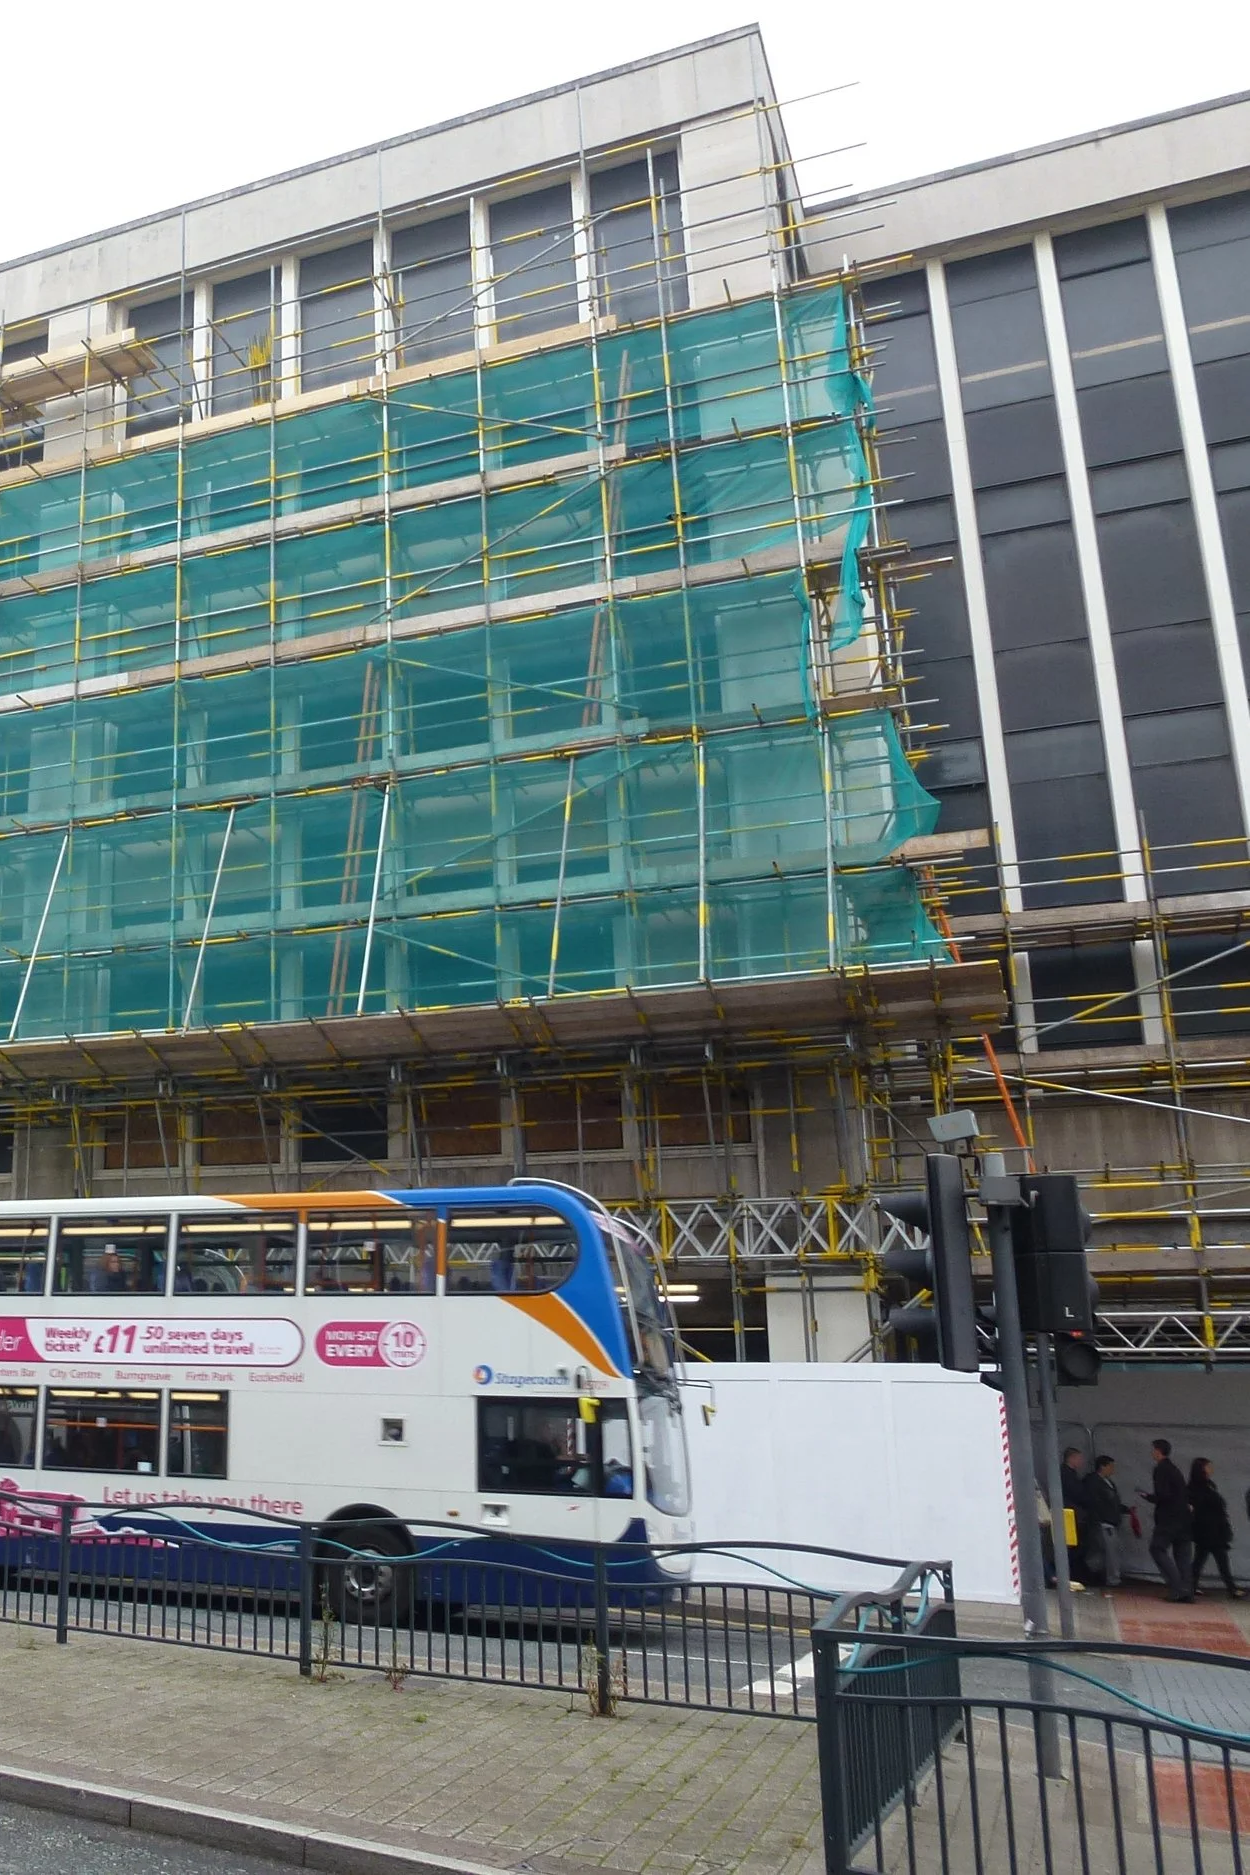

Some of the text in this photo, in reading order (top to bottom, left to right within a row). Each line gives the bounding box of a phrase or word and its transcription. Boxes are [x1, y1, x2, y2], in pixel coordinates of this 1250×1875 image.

[44, 1326, 91, 1342] Weekly
[168, 1330, 206, 1341] seven
[210, 1328, 243, 1343] days
[392, 1331, 415, 1348] 10
[44, 1340, 81, 1353] ticket
[143, 1341, 209, 1355] unlimited
[213, 1342, 255, 1355] travel
[325, 1344, 377, 1357] EVERY
[49, 1368, 67, 1380] City
[70, 1369, 102, 1379] Centre
[103, 1486, 132, 1504] Let
[136, 1492, 157, 1503] us
[161, 1489, 203, 1507] take
[250, 1493, 304, 1515] there
